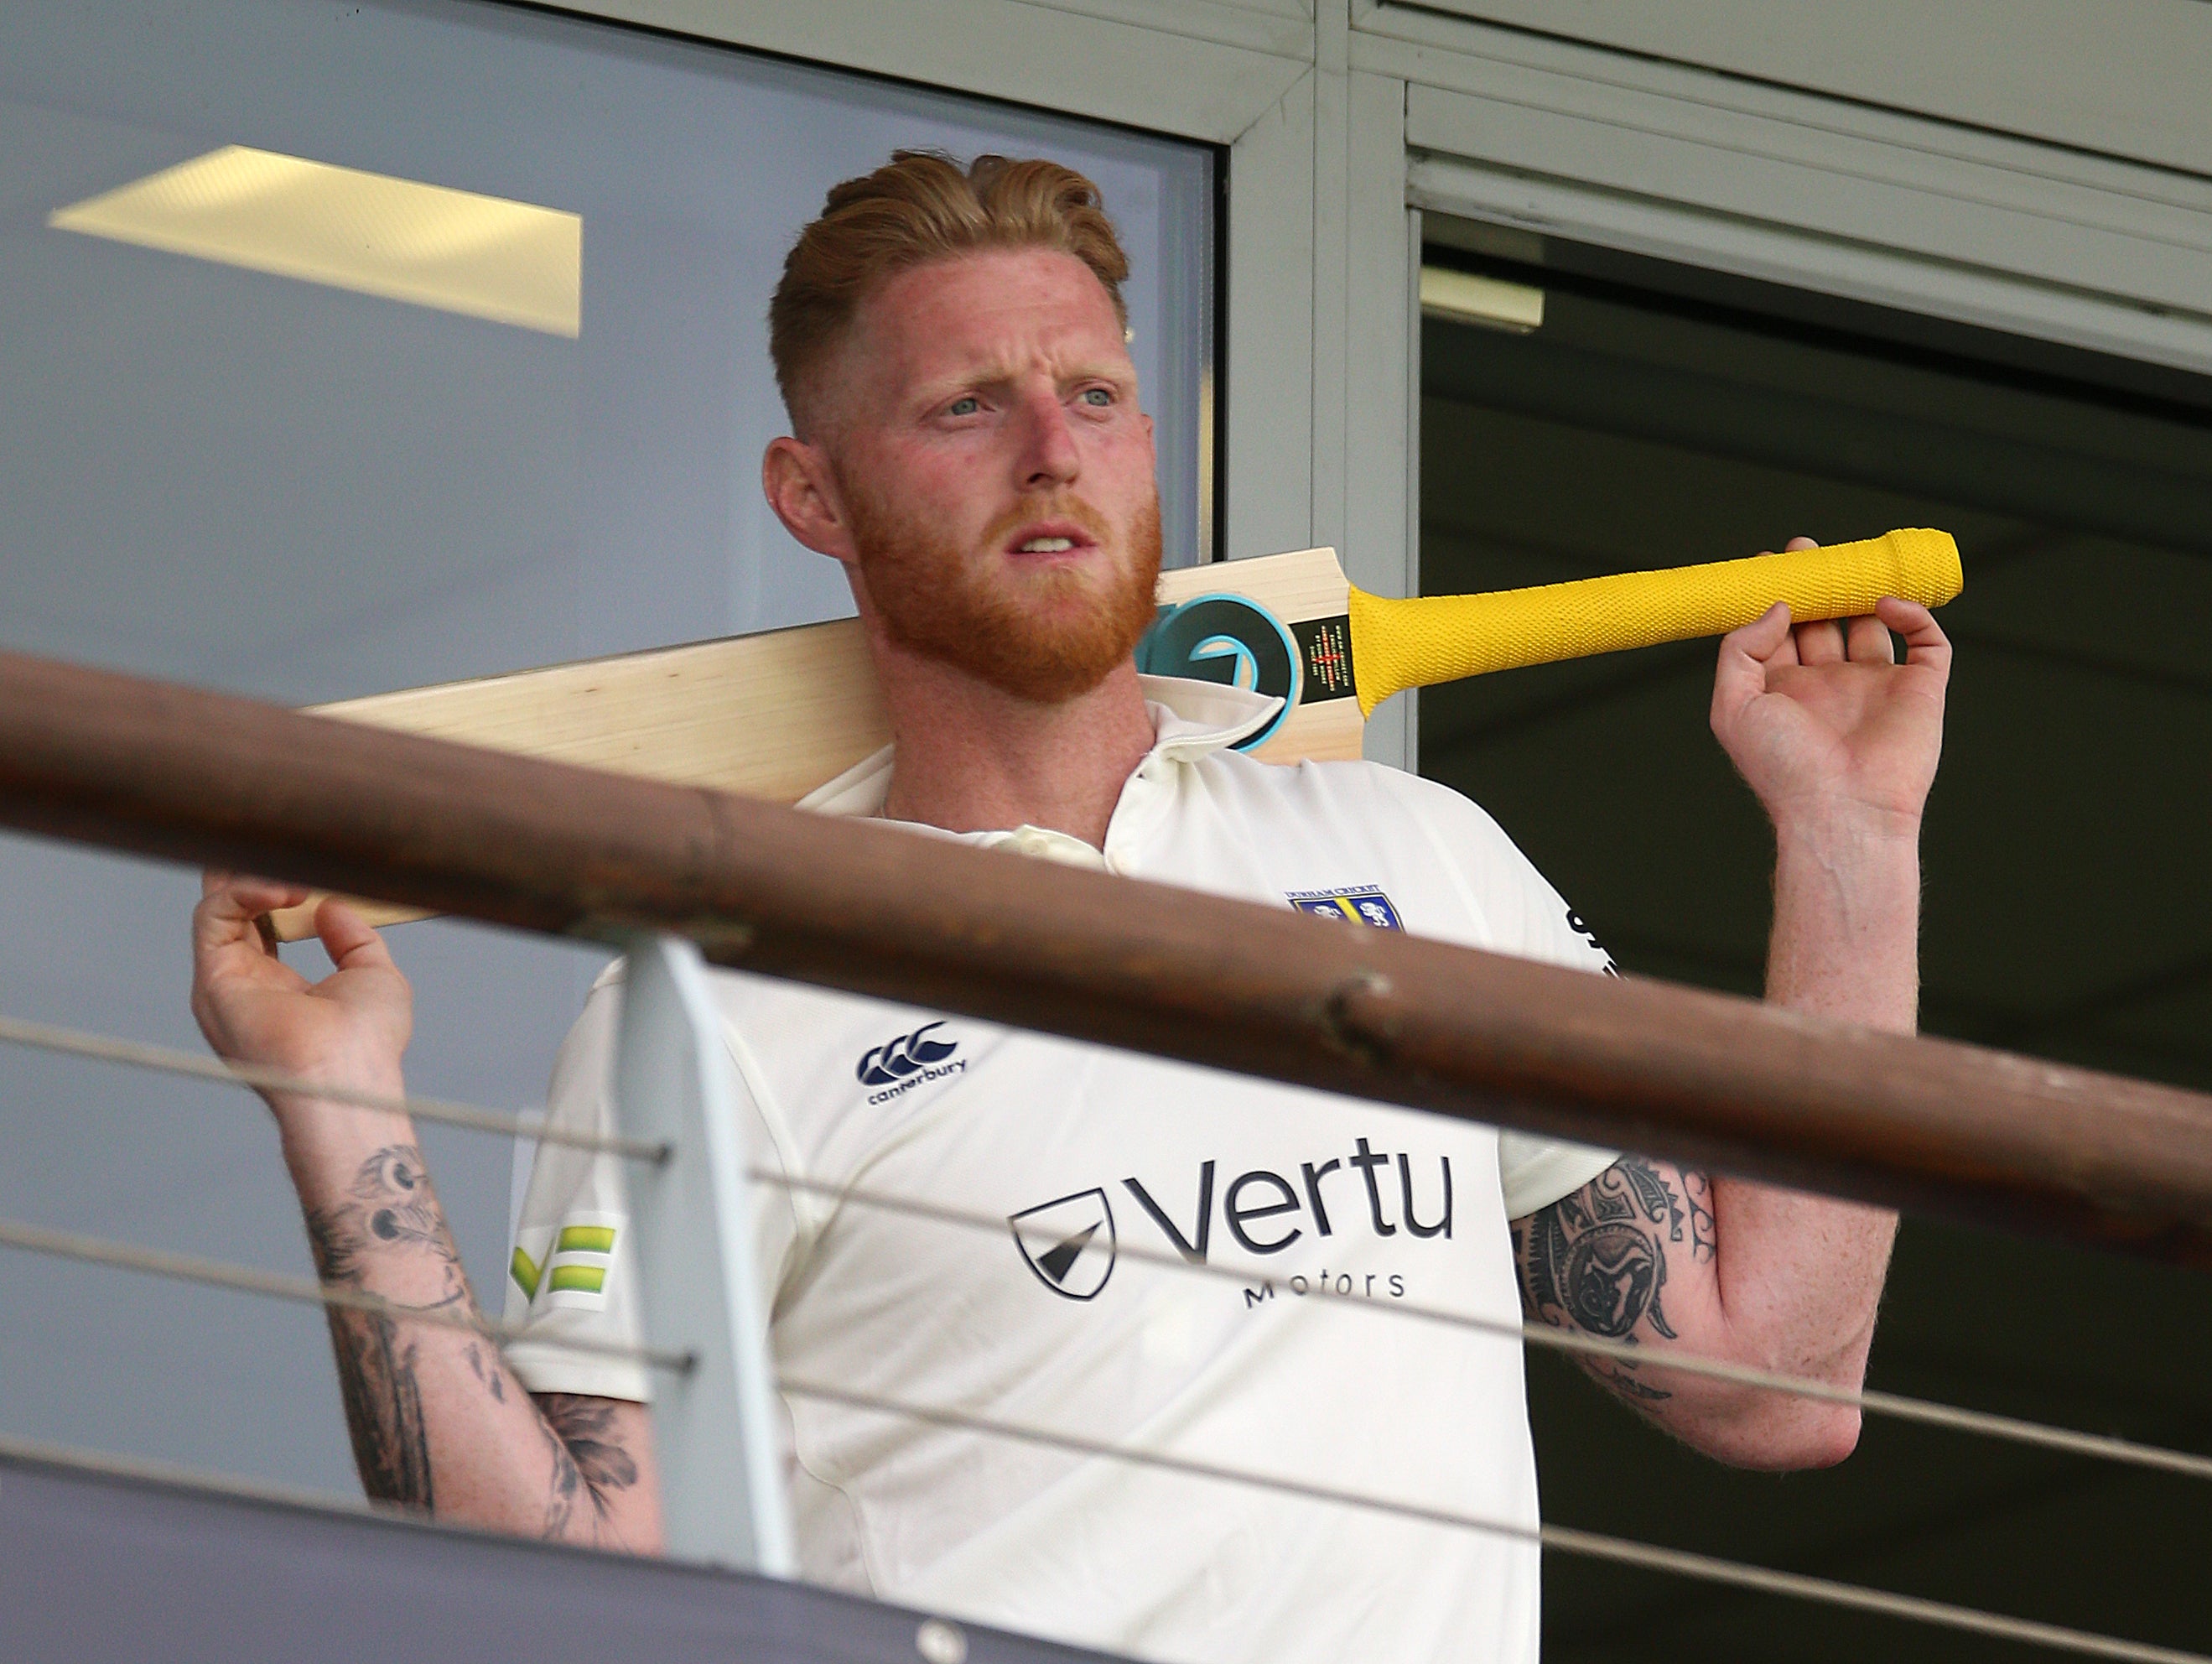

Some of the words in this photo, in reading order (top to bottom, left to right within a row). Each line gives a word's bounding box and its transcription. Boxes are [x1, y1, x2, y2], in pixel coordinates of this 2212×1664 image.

[1285, 890, 1334, 898] DURHAM
[1335, 884, 1381, 896] CRICKET
[868, 1059, 966, 1105] canterbury
[1121, 1137, 1452, 1265] Vertu
[1243, 1269, 1406, 1308] Motors
